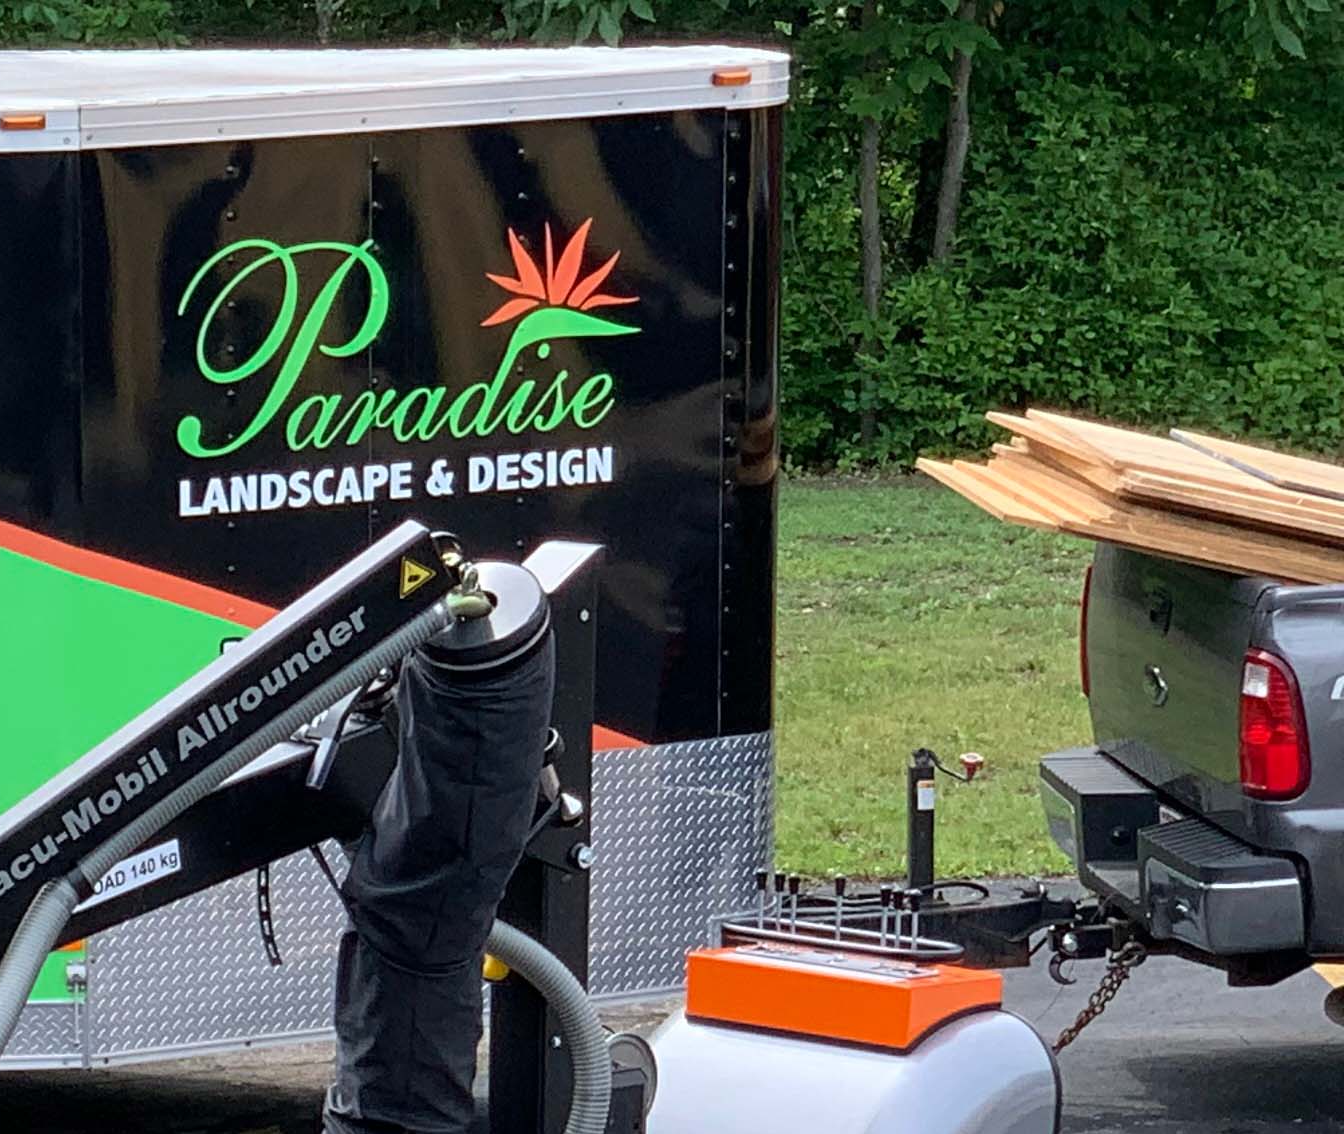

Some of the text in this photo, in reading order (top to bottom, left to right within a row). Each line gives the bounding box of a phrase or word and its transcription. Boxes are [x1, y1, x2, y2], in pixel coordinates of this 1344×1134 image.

[176, 238, 616, 458] Paradise
[178, 446, 614, 517] LANDSCAPE & DESIGN
[174, 604, 368, 763] Allrounder
[130, 858, 156, 879] 140
[160, 852, 178, 869] kg
